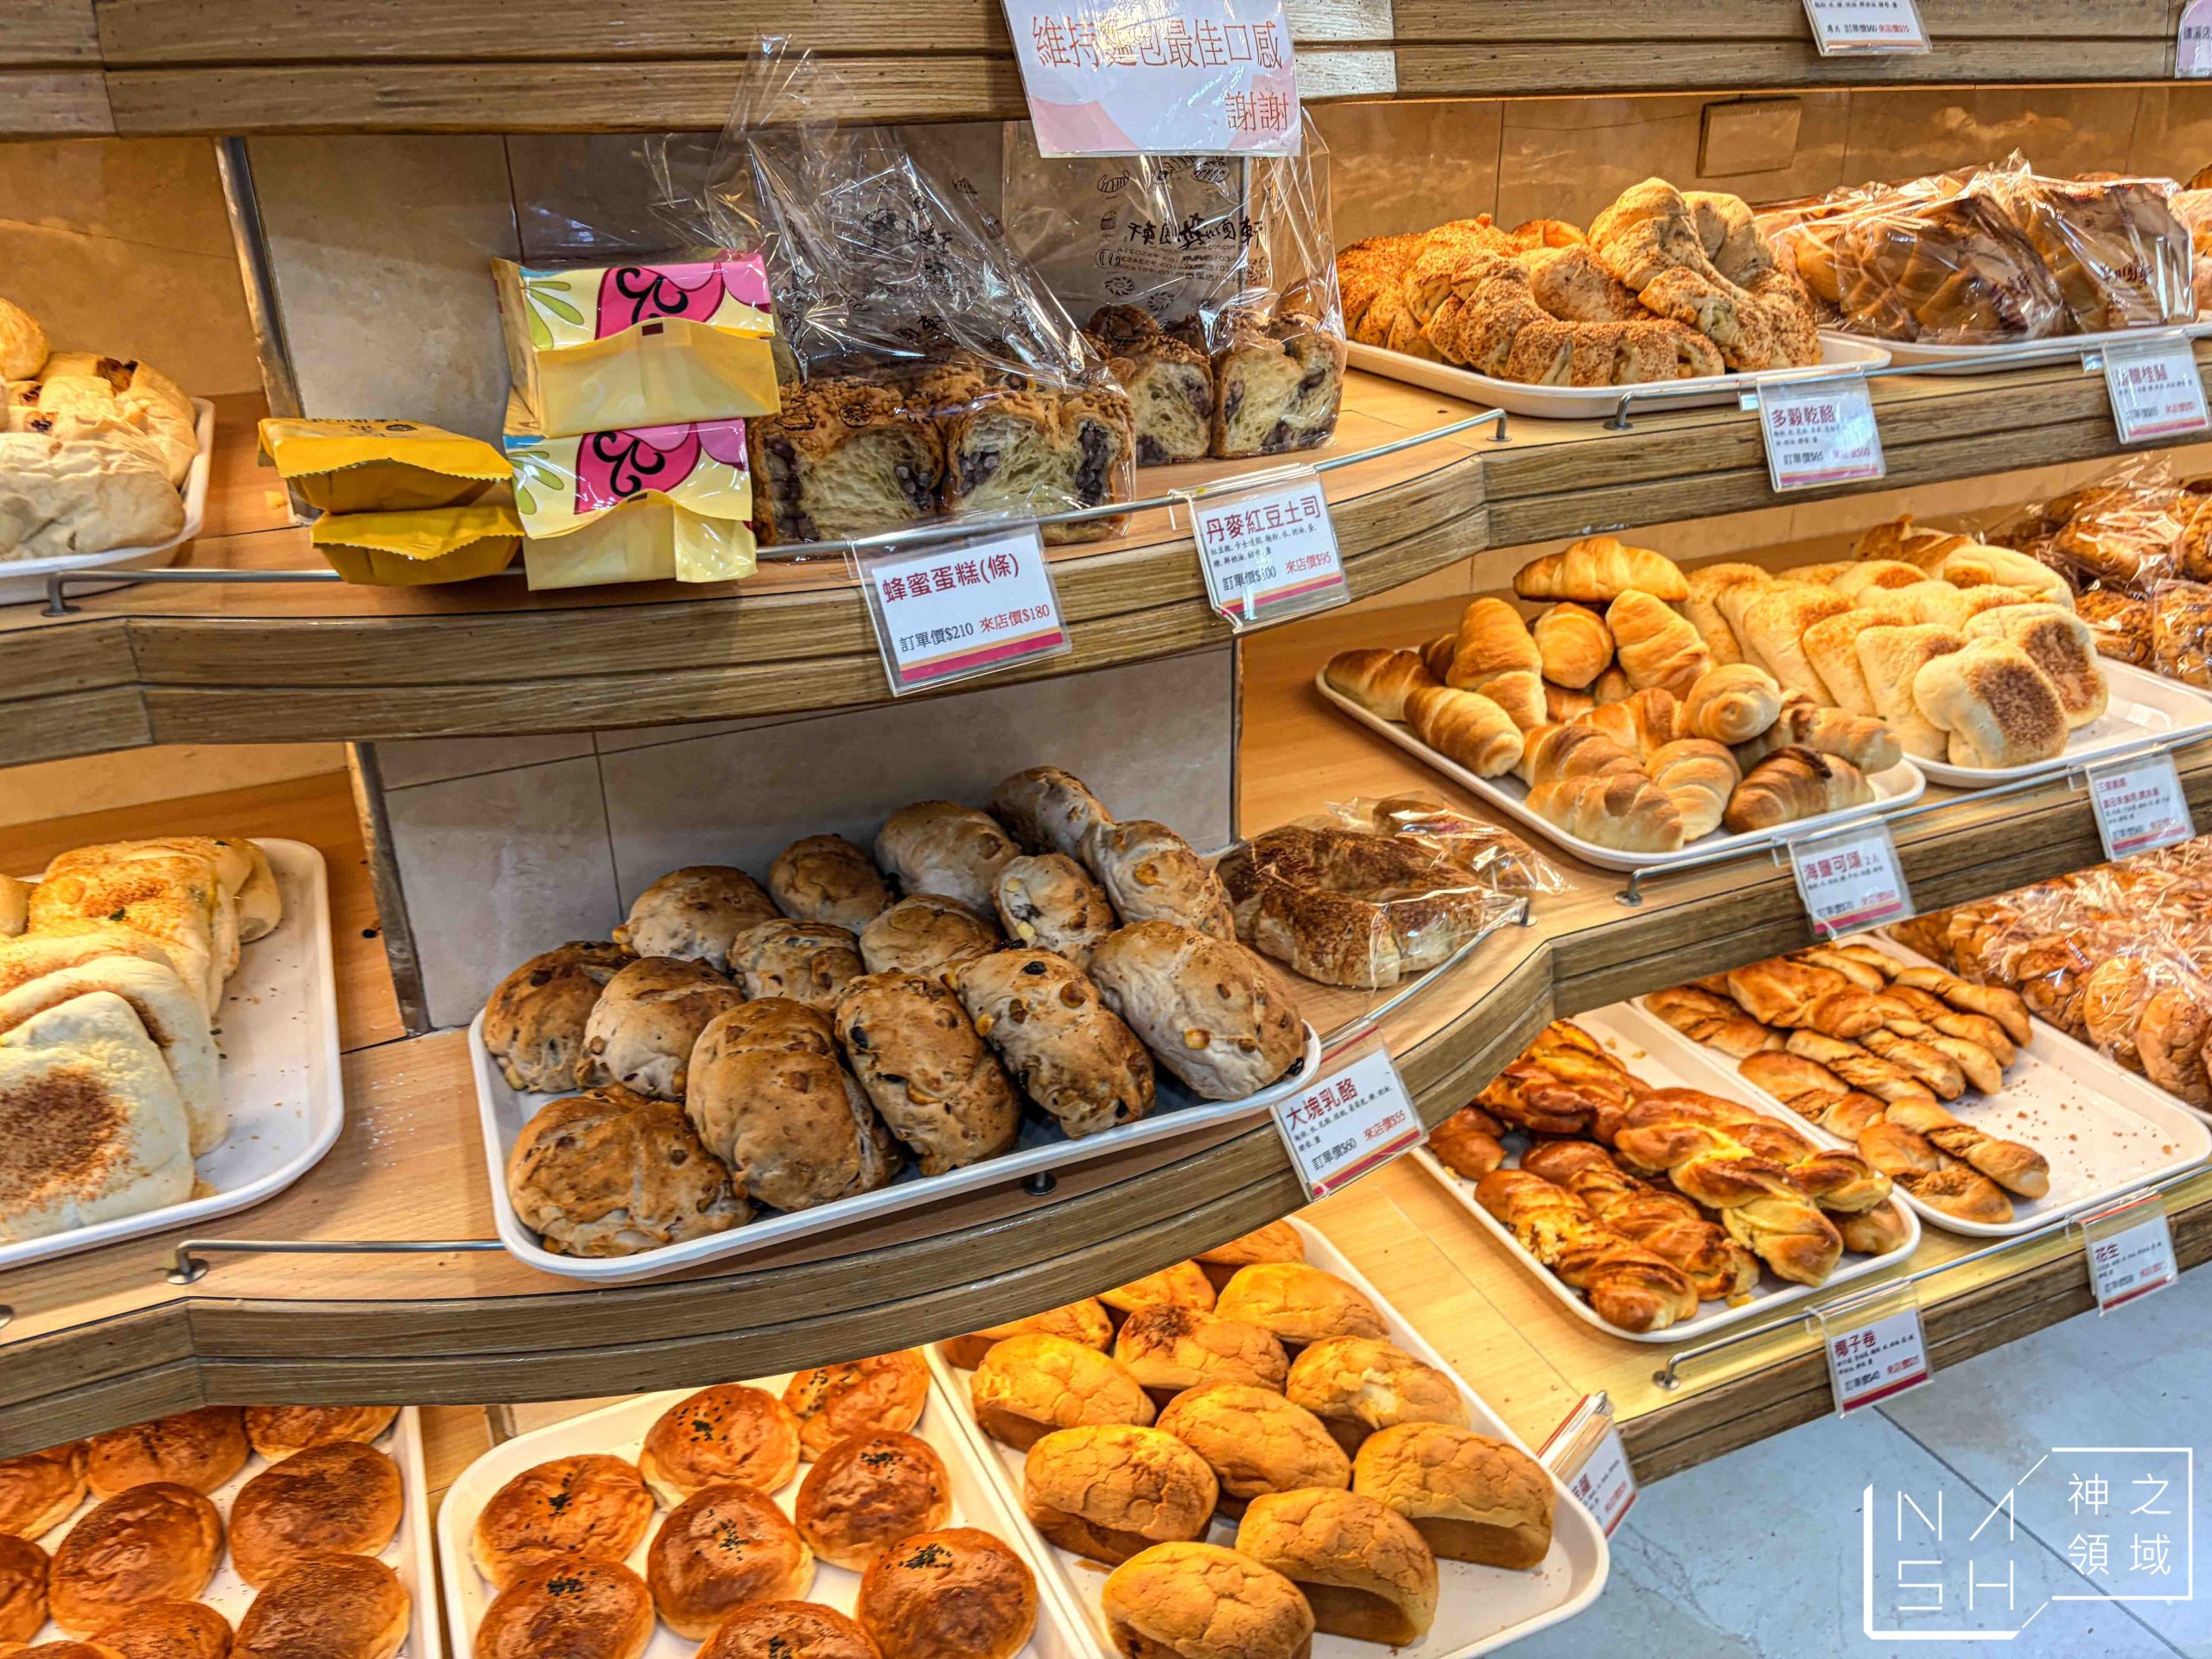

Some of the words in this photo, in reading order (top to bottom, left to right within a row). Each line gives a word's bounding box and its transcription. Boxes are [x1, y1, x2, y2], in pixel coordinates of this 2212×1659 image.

[1224, 91, 1289, 131] 謝謝
[1205, 495, 1321, 543] 丹麥紅豆土司
[882, 553, 1020, 603] 蜂蜜蛋糕(條)
[1285, 551, 1332, 574] 來店價$95
[899, 622, 974, 652] 訂單價$210
[979, 604, 1050, 633] 來店價$180
[1286, 1077, 1359, 1131] 大塊乳酪
[1311, 1137, 1357, 1171] 訂單價$60
